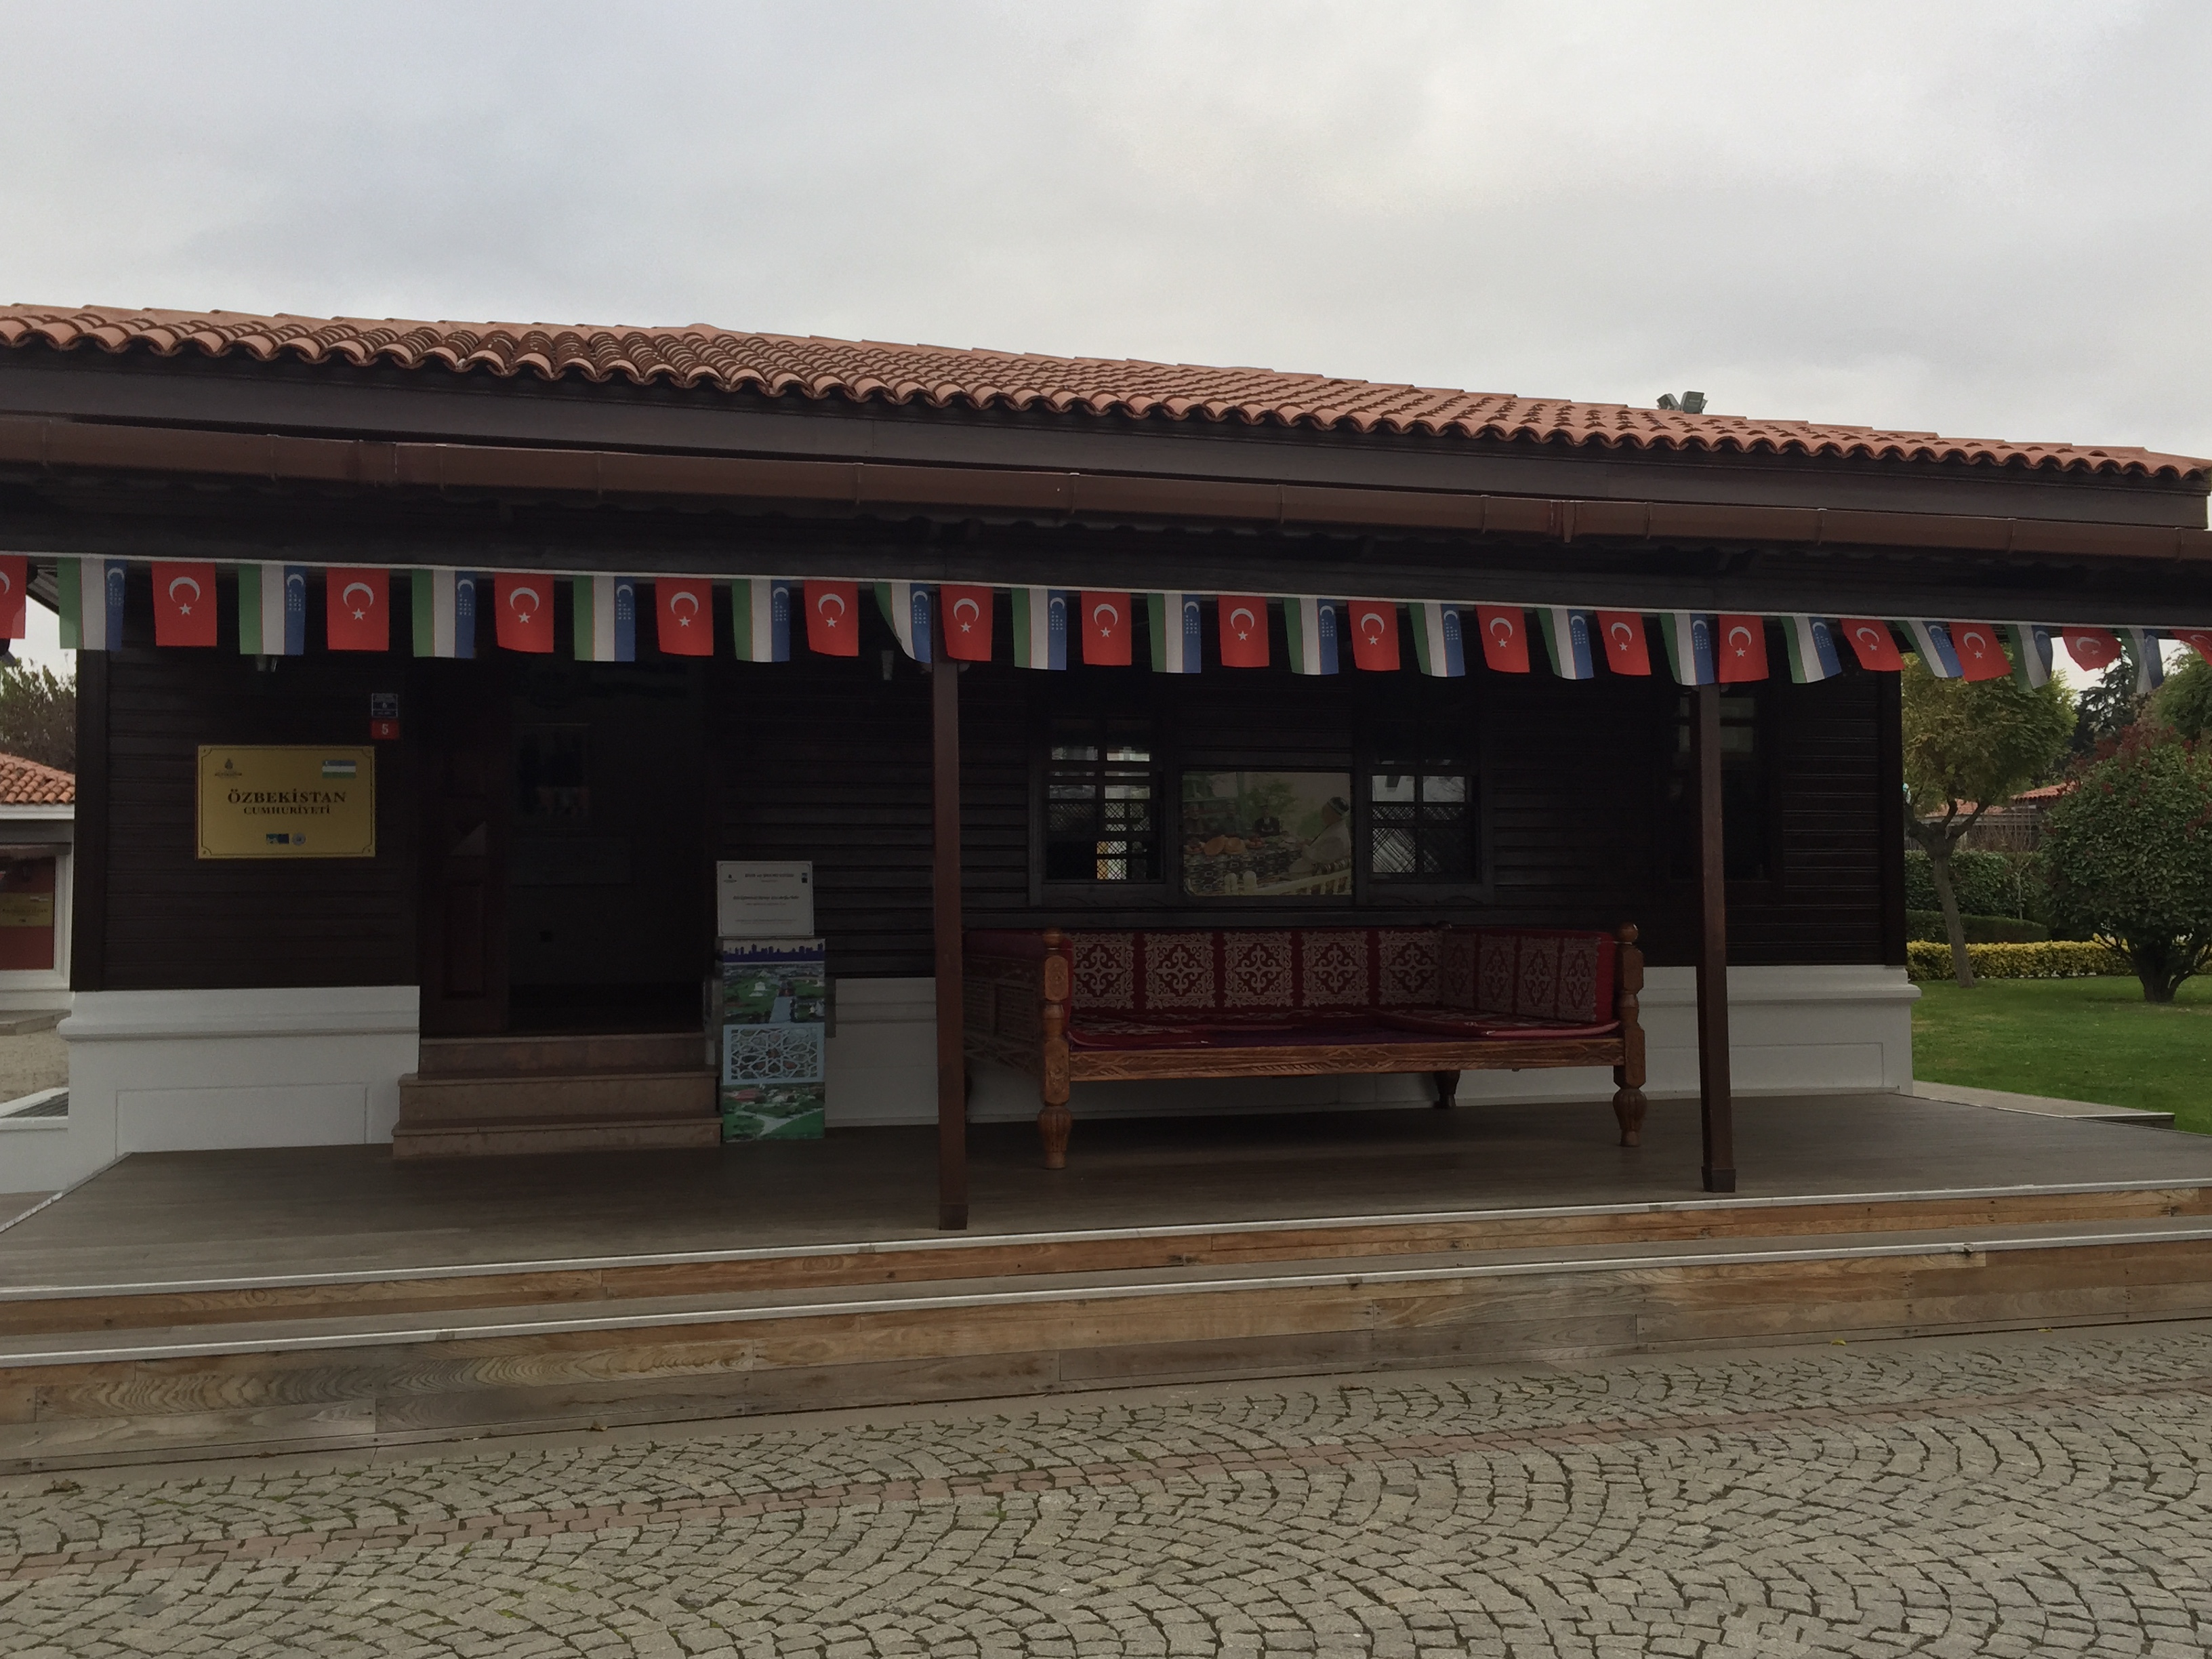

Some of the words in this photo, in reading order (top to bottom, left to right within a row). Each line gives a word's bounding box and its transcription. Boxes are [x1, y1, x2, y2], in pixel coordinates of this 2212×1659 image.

[382, 723, 389, 735] 5
[228, 788, 346, 803] ÖZBEKİSTAN
[244, 804, 331, 815] CUMHURİYETİ
